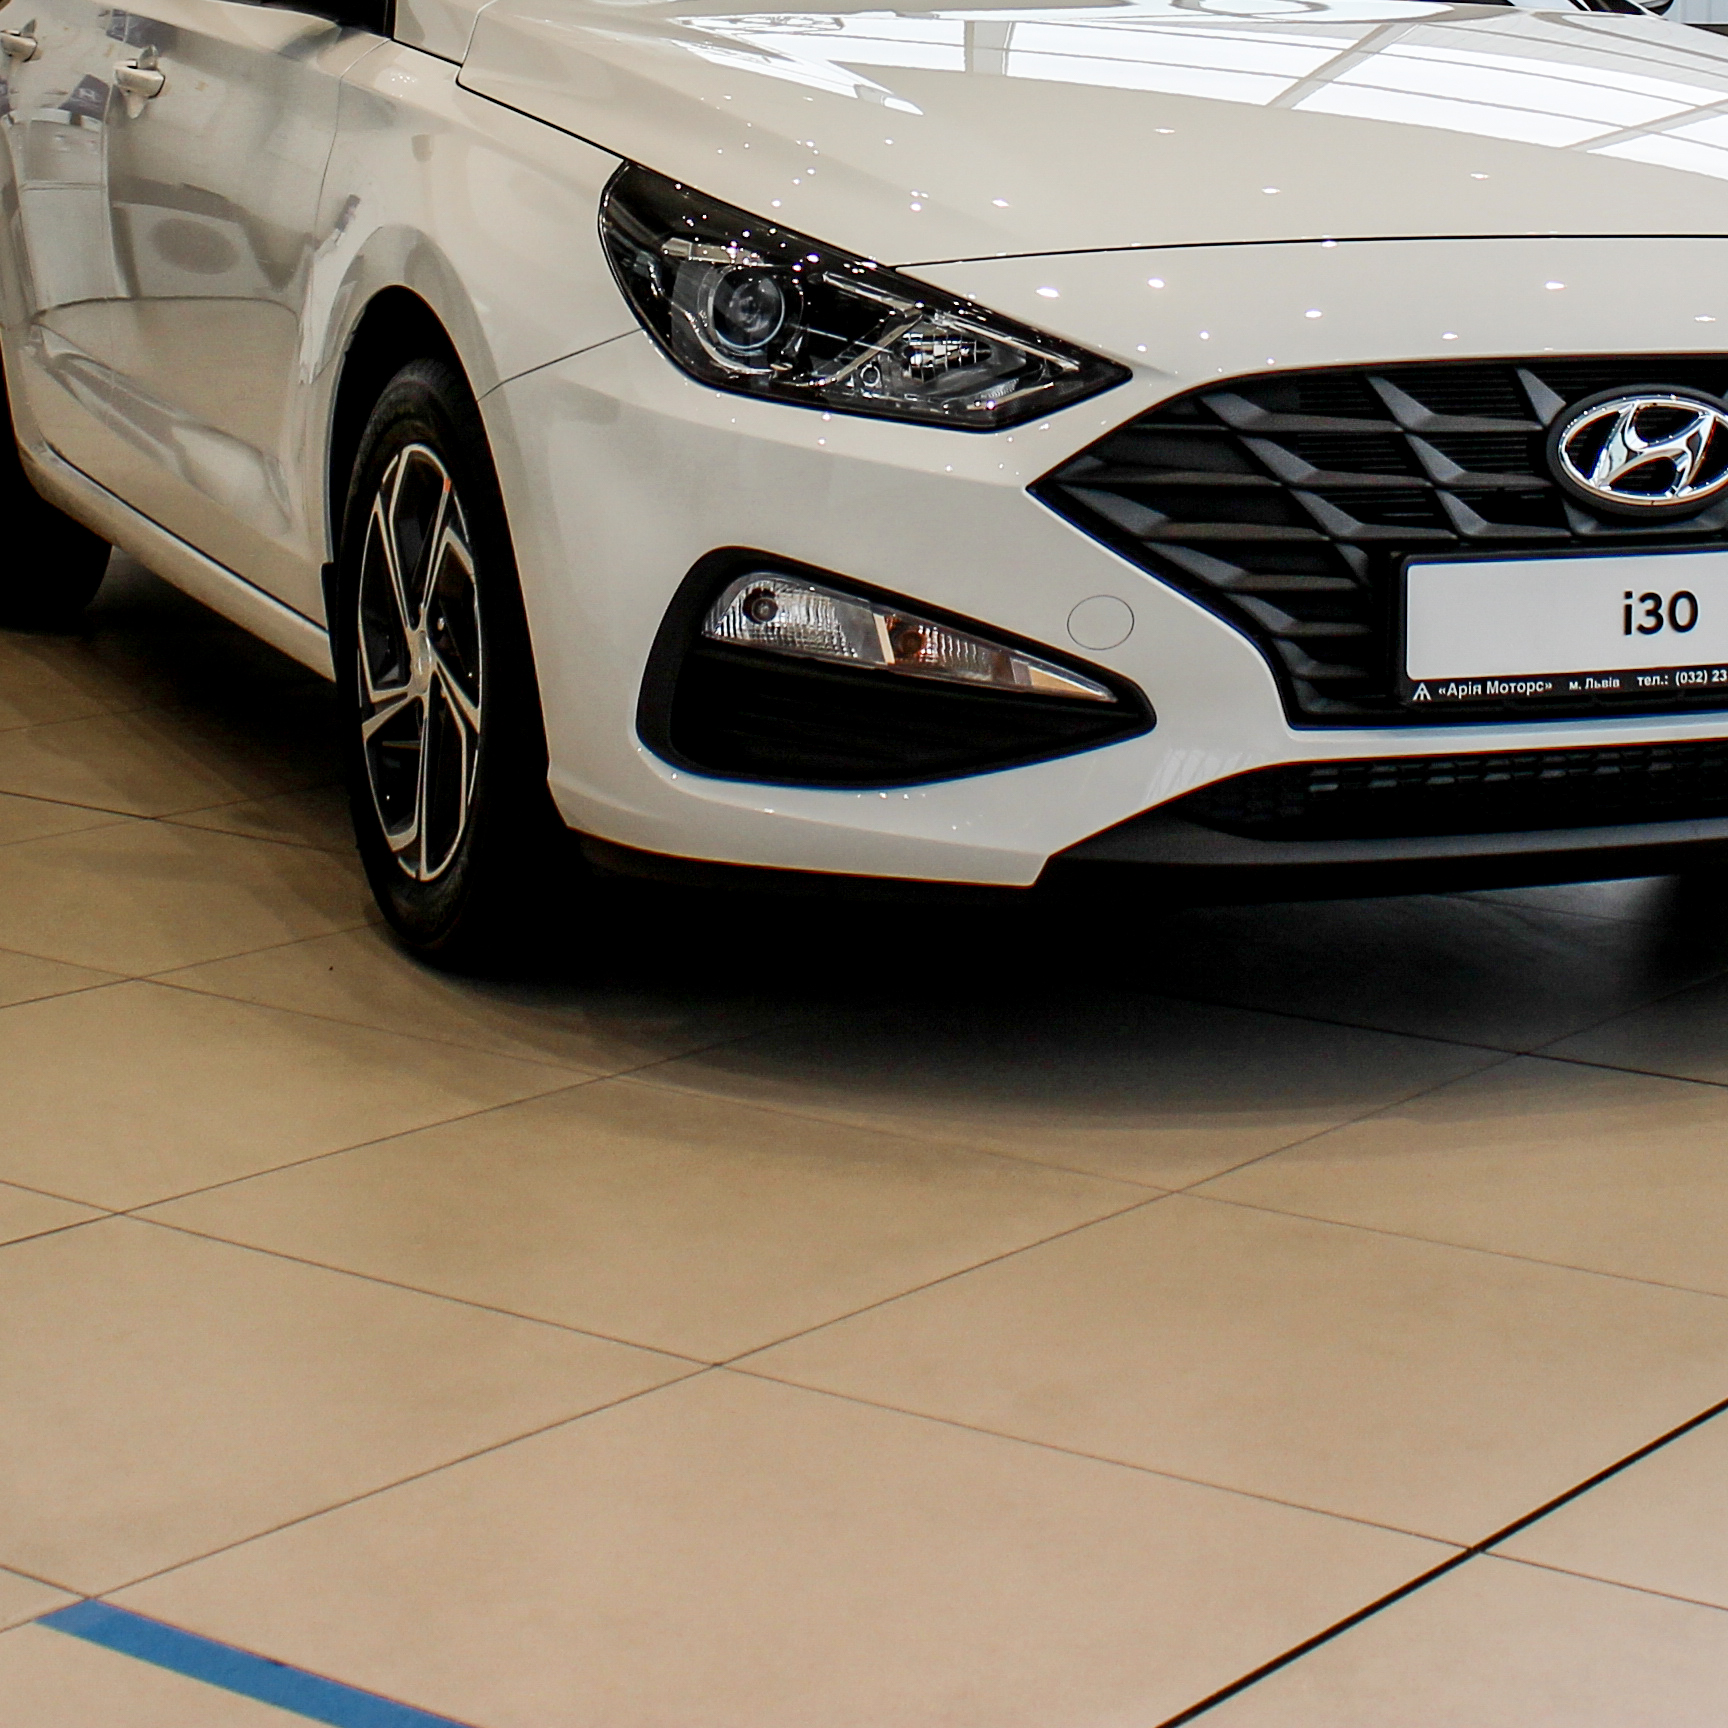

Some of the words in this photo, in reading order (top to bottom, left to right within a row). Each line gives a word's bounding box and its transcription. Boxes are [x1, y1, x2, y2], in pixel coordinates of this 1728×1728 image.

[1624, 590, 1699, 636] i30
[1438, 682, 1482, 700] «Арія
[1486, 680, 1553, 696] Моторс»
[1584, 676, 1620, 689] Львів
[1675, 670, 1708, 686] (032)
[1711, 670, 1727, 682] 23
